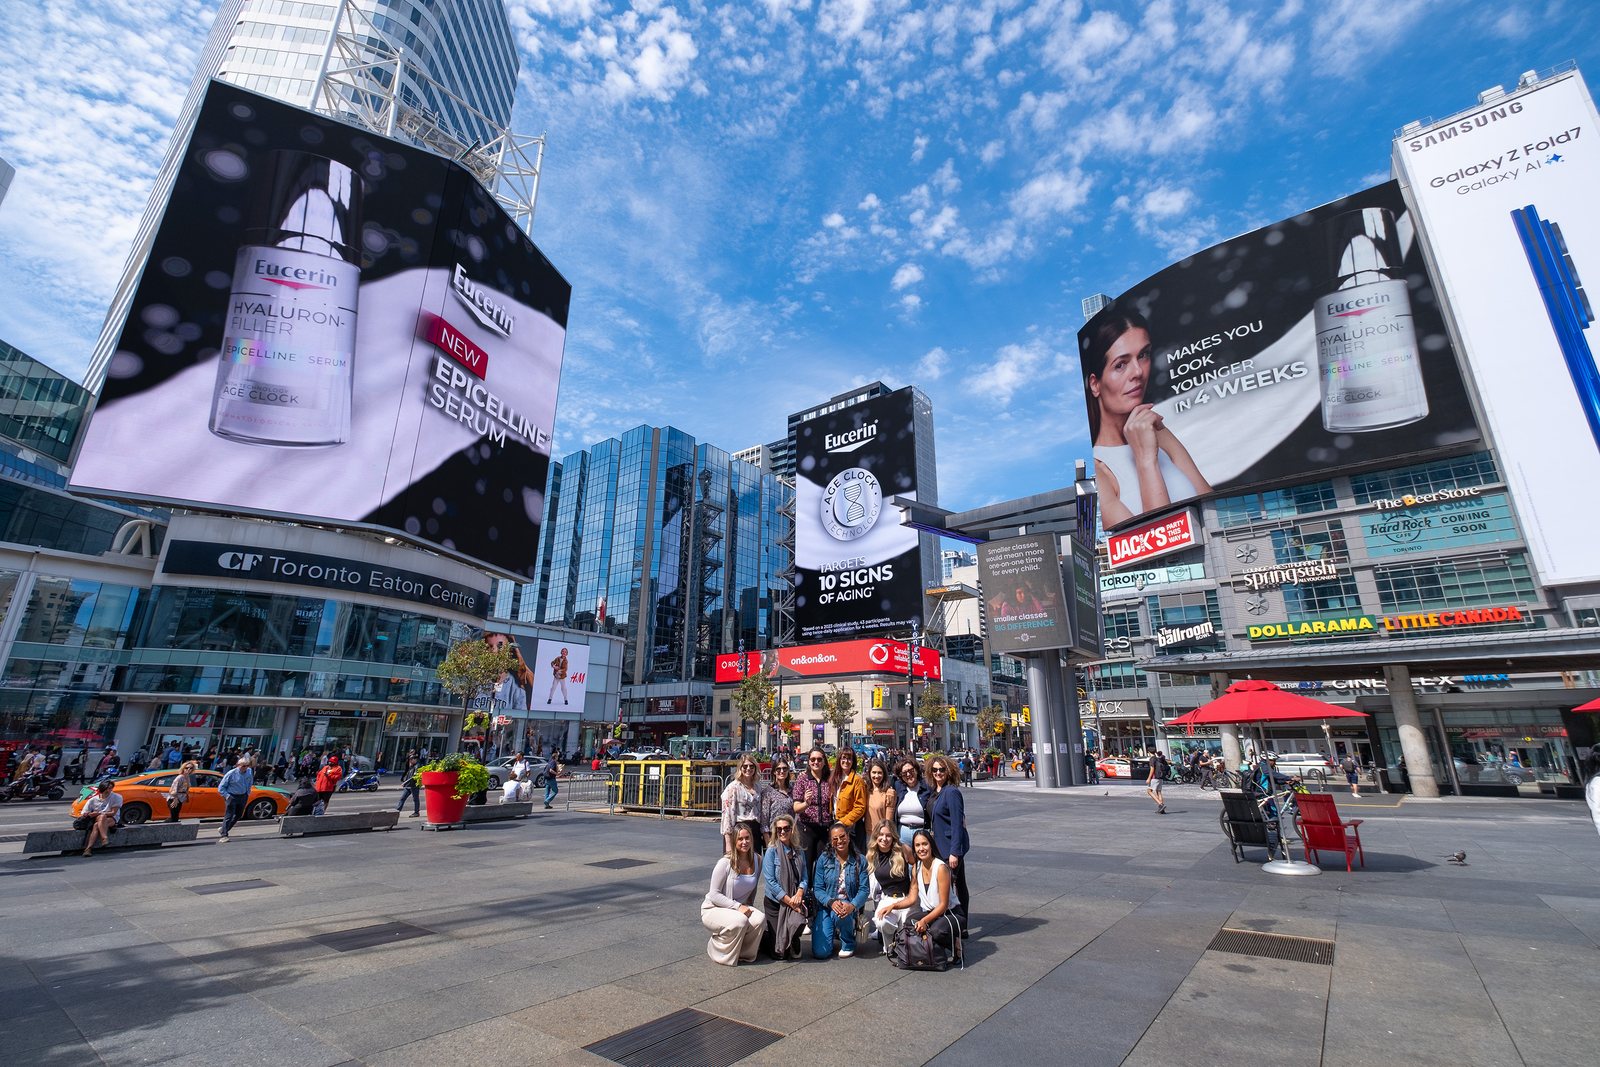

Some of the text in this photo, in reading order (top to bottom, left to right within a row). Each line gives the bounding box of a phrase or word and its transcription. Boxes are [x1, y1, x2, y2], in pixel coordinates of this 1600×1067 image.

[1409, 101, 1523, 153] SAMSUNG
[1430, 126, 1581, 188] Galaxy Z Fold7
[1456, 159, 1541, 195] Galaxy AI
[254, 259, 337, 287] Eucerin
[452, 262, 514, 335] Eucerin
[1327, 292, 1391, 317] Eucerin
[234, 301, 345, 328] HYALURON-
[231, 316, 293, 336] FILLER
[1320, 322, 1404, 348] HYALURON-
[441, 327, 481, 367] NEW
[1166, 320, 1263, 364] MAKES YOU
[1321, 341, 1365, 358] FILLER
[226, 345, 346, 368] EPICELLINE SERUM
[1169, 353, 1215, 379] LOOK
[1380, 354, 1412, 366] SERUM
[1171, 359, 1254, 395] YOUNGER
[1174, 361, 1309, 413] IN 4 WEEKS
[223, 386, 299, 404] AGE CLOCK
[1327, 395, 1341, 403] AGE
[1344, 390, 1381, 402] CLOCK
[430, 383, 506, 449] SERUM
[824, 422, 877, 450] Eucerin
[824, 471, 877, 505] AGE CLOCK
[1373, 486, 1481, 511] The Beer Store
[828, 503, 879, 538] TECHNOLOGY
[1166, 519, 1184, 530] PARTY
[1370, 517, 1432, 535] Hard Rock
[1441, 511, 1490, 524] COMING
[1167, 528, 1182, 537] THIS
[1453, 522, 1487, 534] SOON
[1012, 542, 1039, 551] classes
[1112, 526, 1167, 561] JACK'S
[1168, 535, 1182, 543] WAY
[819, 556, 866, 573] TARGETS
[985, 549, 1045, 563] would mean more
[819, 564, 893, 591] 10 SIGNS
[1001, 567, 1019, 575] every
[1020, 564, 1040, 572] child.
[1101, 572, 1156, 587] TORONTO
[270, 555, 361, 585] Toronto
[368, 570, 424, 596] Eaton
[429, 583, 475, 609] Centre
[819, 592, 835, 604] OF
[993, 611, 1048, 623] smaller classes
[994, 619, 1055, 632] BIG DIFFERENCE
[1439, 606, 1521, 626] CANADA
[1157, 621, 1214, 648] ballroom
[1159, 627, 1172, 635] The
[1195, 633, 1211, 641] BOWL
[1249, 616, 1374, 638] DOLLARAMA
[728, 659, 750, 668] ROGS
[790, 654, 837, 666] on&on&on.
[1332, 675, 1454, 690] CINEEX
[1463, 673, 1511, 683] IMAX
[1084, 701, 1124, 715] SACK
